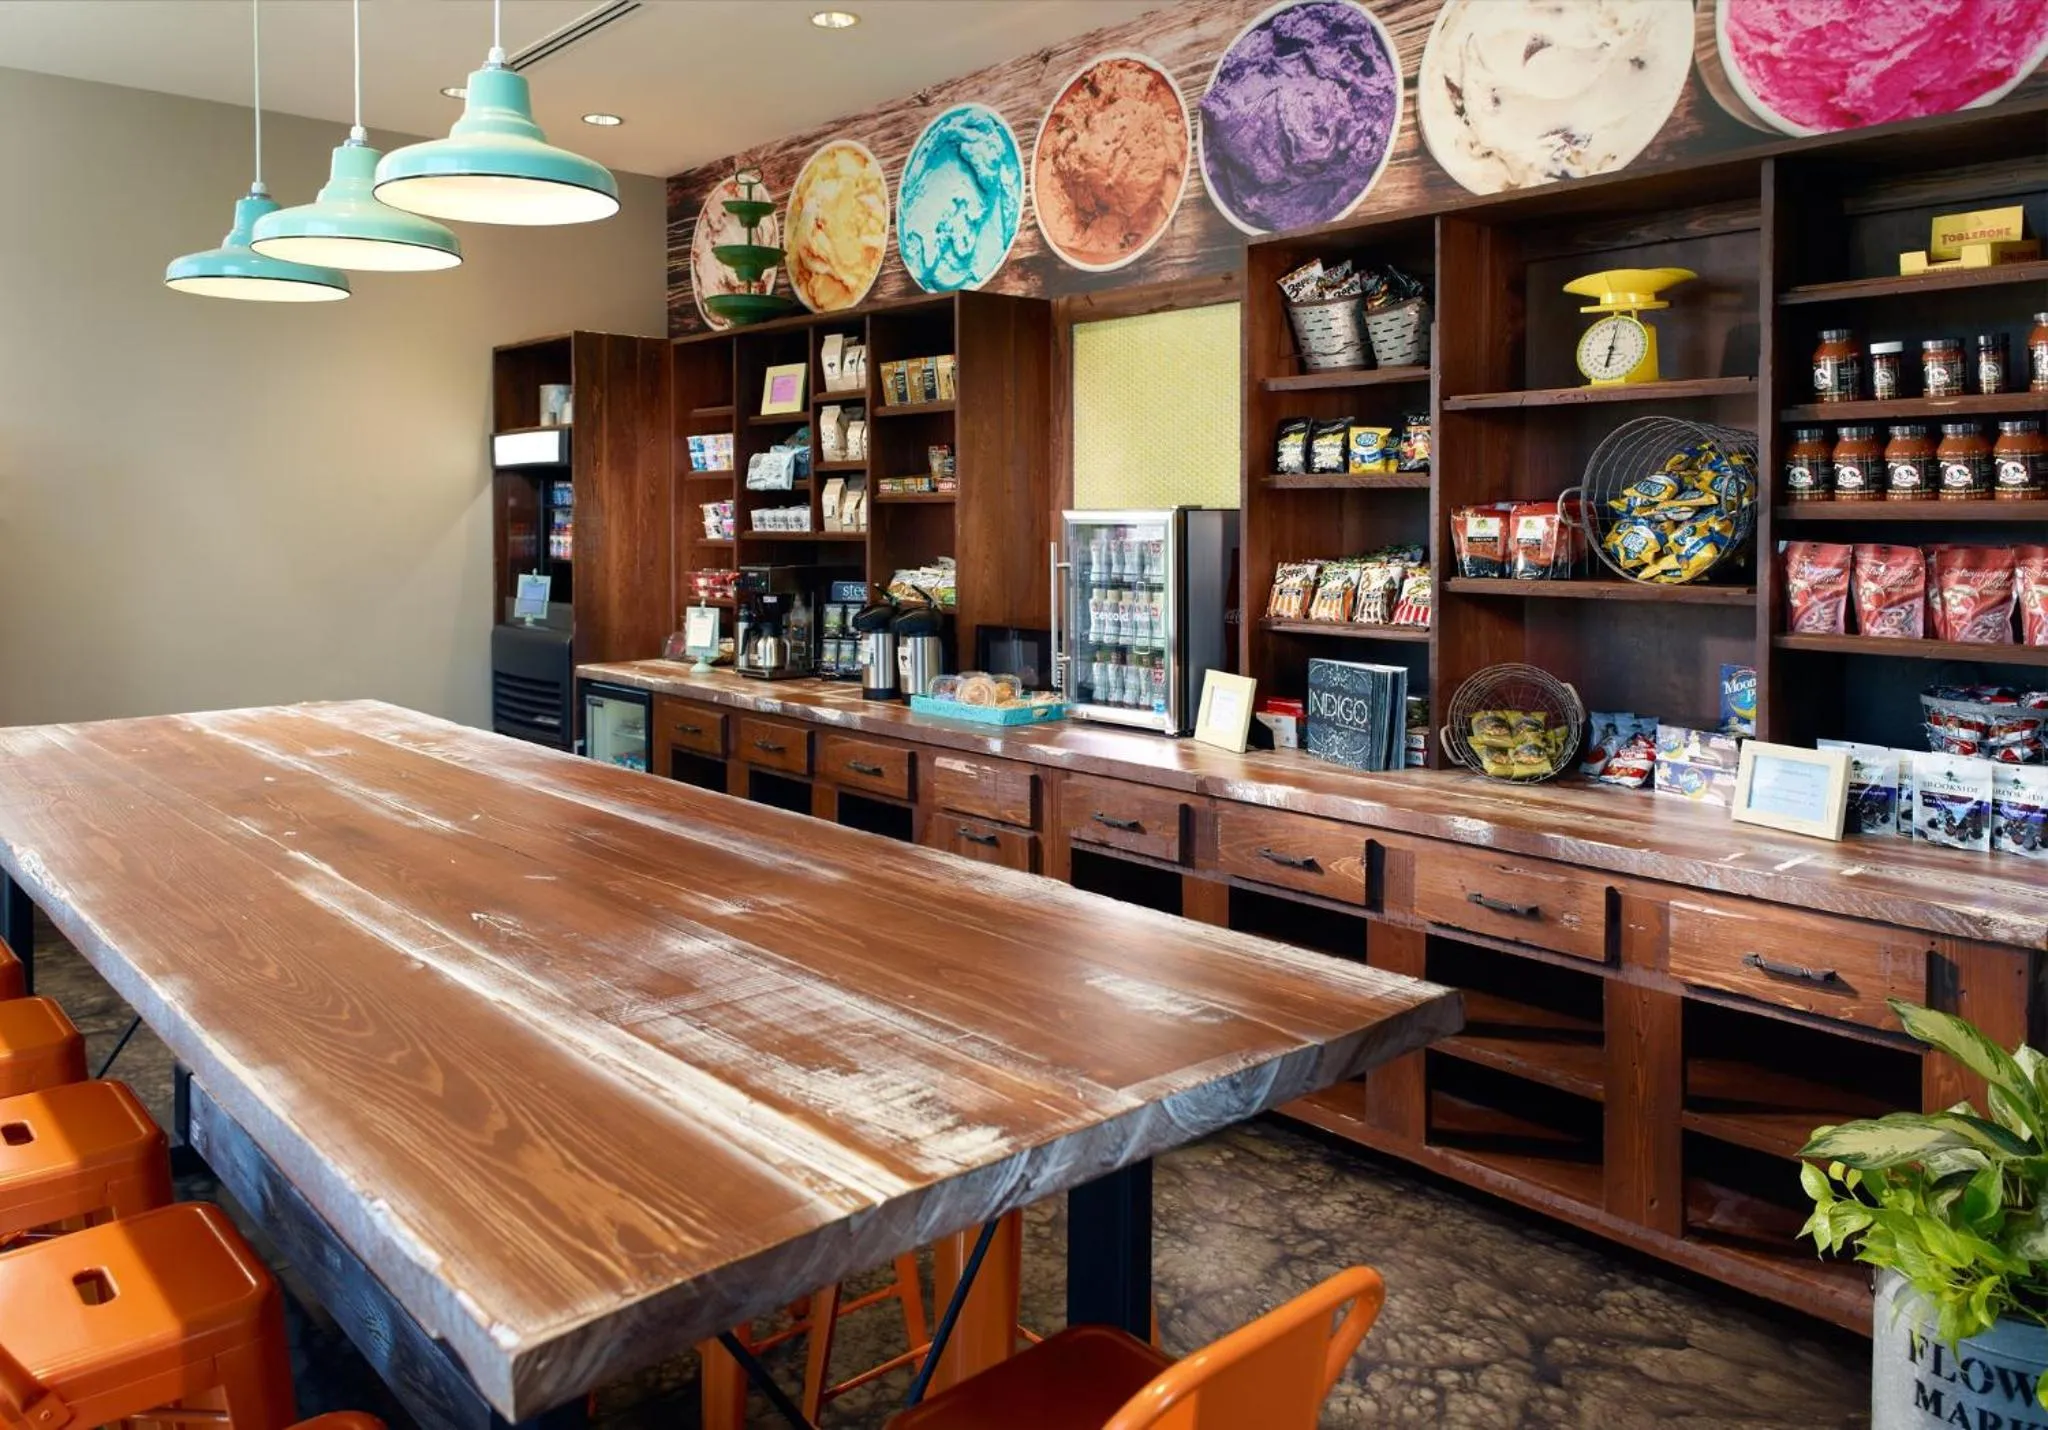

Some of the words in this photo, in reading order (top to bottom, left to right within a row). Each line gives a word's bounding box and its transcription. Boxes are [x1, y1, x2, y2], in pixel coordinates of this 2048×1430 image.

[1941, 227, 2012, 245] TOBLERONE
[1723, 677, 1757, 695] Moon
[1308, 687, 1368, 725] INDIGO
